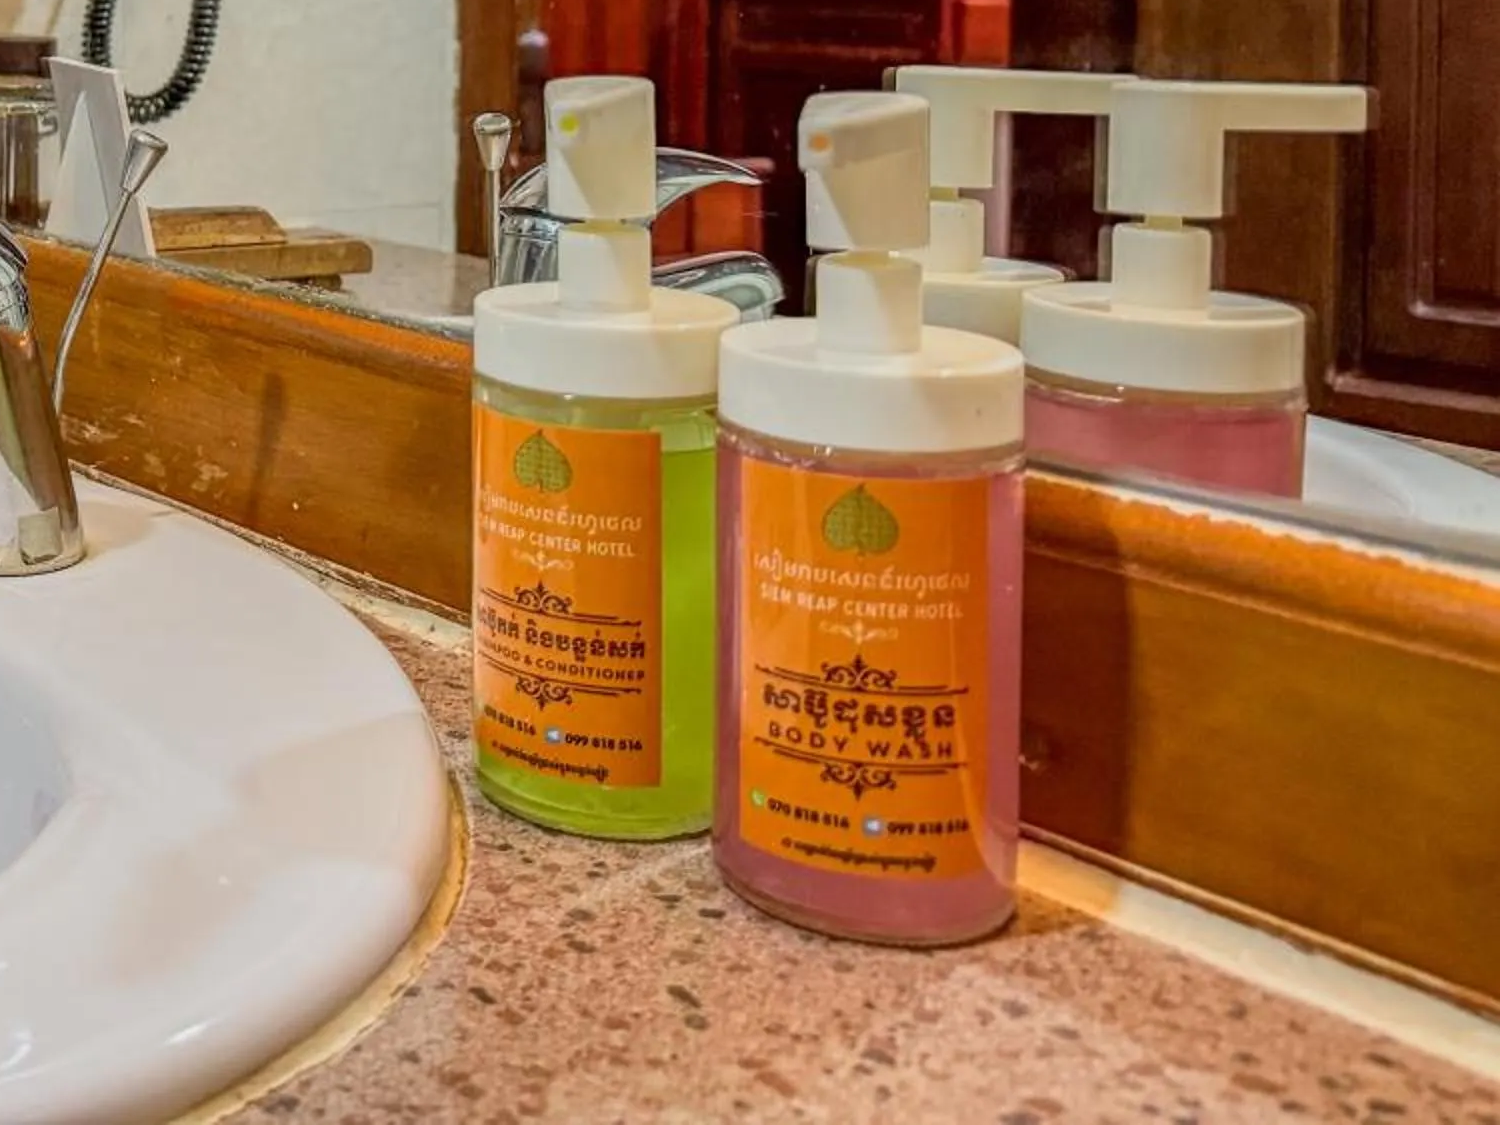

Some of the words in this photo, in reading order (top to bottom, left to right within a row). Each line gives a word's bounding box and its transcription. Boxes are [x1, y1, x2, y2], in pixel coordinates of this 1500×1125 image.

[529, 531, 582, 554] CENTER
[587, 540, 636, 557] HOTEL
[796, 589, 838, 612] REAP
[843, 600, 909, 620] CENTER
[913, 602, 964, 619] HOTEL
[523, 654, 533, 667] &
[535, 658, 645, 681] CONDITIONER
[565, 732, 589, 747] 099
[769, 721, 849, 753] BODY
[866, 739, 953, 759] WASH
